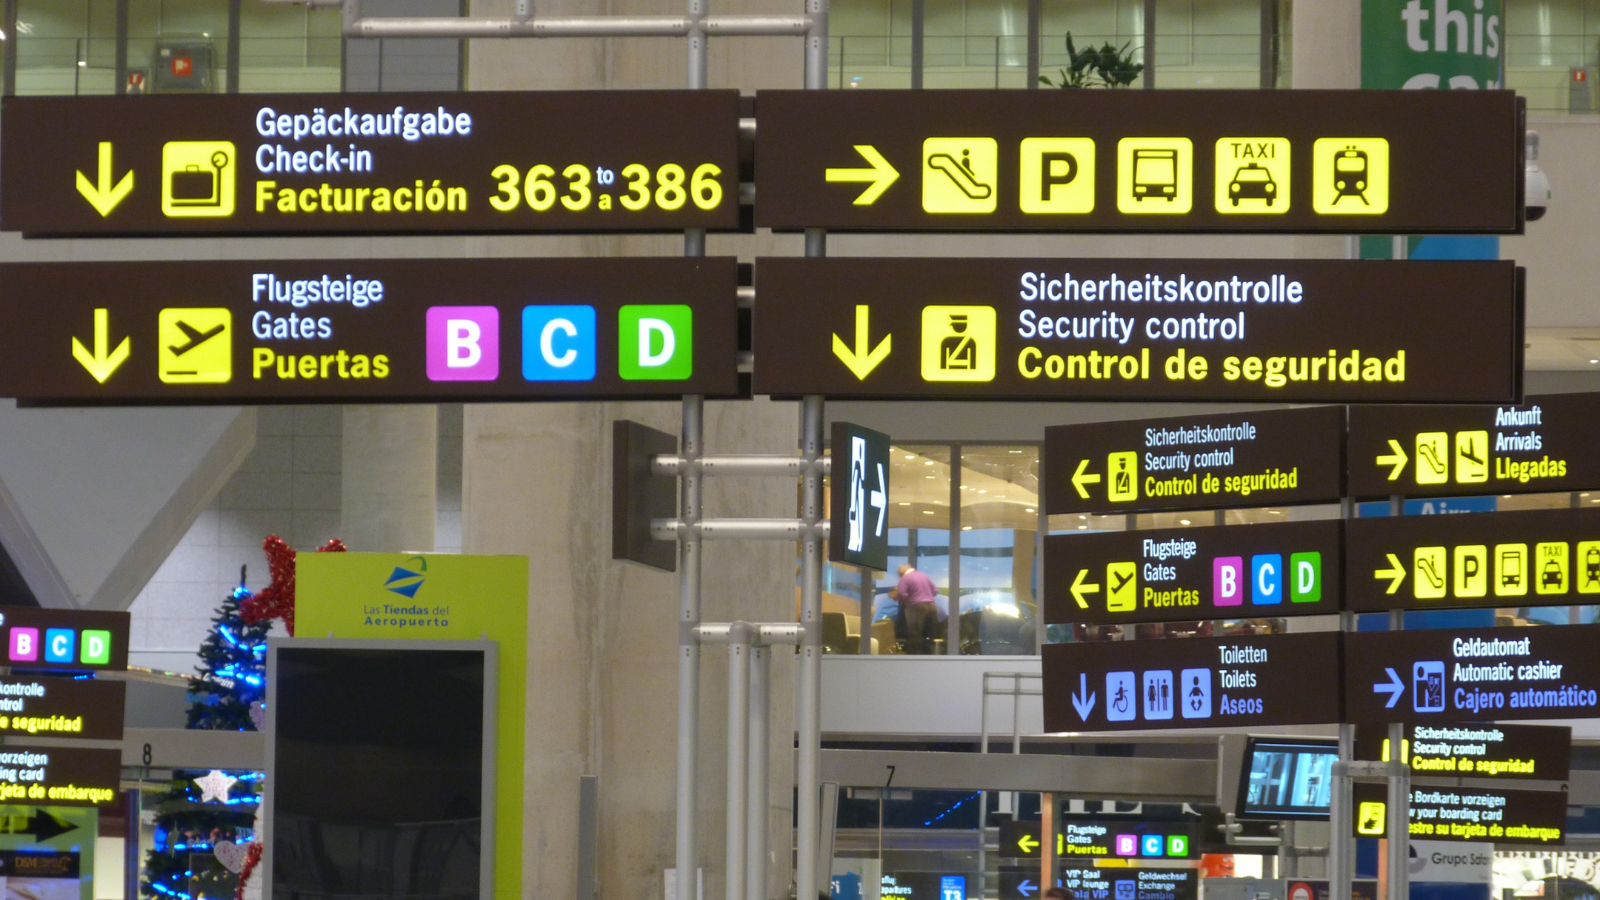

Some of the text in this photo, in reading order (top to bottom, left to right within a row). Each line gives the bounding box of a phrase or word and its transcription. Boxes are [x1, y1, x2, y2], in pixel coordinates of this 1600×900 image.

[1401, 0, 1499, 58] this
[255, 105, 472, 142] Gepäckaufgabe
[255, 143, 373, 173] Check-in
[1231, 143, 1275, 158] TAXI
[489, 162, 723, 211] 363 to a 386
[1041, 152, 1078, 201] P
[255, 180, 467, 212] Facturación
[252, 272, 384, 308] Flugsteige
[1019, 272, 1304, 304] Sicherheitskontrolle
[252, 309, 333, 340] Gates
[1018, 309, 1245, 344] Security control
[447, 317, 676, 368] B C D
[252, 348, 390, 379] Puertas
[1017, 347, 1406, 388] Control de seguridad
[1495, 405, 1542, 427] Ankunft
[1145, 421, 1256, 447] Sicherheitskontrolle
[1496, 431, 1542, 451] Arrivals
[1145, 447, 1234, 472] Security control
[1496, 455, 1566, 484] Llegadas
[1145, 467, 1298, 497] Control de seguridad
[1143, 538, 1197, 560] Flugsteige
[1543, 545, 1563, 557] TAXI
[1143, 563, 1177, 581] Gates
[1221, 561, 1315, 598] B C D
[1463, 554, 1479, 589] P
[1143, 587, 1200, 608] Puertas
[364, 604, 450, 616] Las Tiendas del
[364, 616, 450, 628] Aeropuerto
[17, 633, 104, 658] B C D
[1218, 645, 1268, 665] Toiletten
[1453, 636, 1531, 657] Geldautomat
[1218, 670, 1257, 688] Toilets
[1453, 660, 1563, 682] Automatic cashier
[1219, 694, 1264, 715] Aseos
[1453, 684, 1598, 713] Cajero automático
[11, 714, 83, 734] seguridad
[1413, 725, 1505, 742] Sicherheitskontrolle
[143, 743, 152, 766] 8
[1412, 740, 1487, 757] Security control
[19, 766, 45, 781] card
[1411, 755, 1536, 775] Control de seguridad
[886, 765, 896, 787] 7
[28, 782, 46, 799] de
[48, 784, 114, 804] embarque
[1415, 790, 1460, 804] Bordkarte
[1461, 794, 1506, 808] vorzeigen
[1417, 807, 1438, 820] your
[1439, 807, 1480, 822] boarding
[1481, 809, 1503, 821] card
[1066, 834, 1093, 844] Gates
[1067, 824, 1107, 836] Flugsteige
[1436, 823, 1450, 835] su
[1450, 823, 1487, 839] tarjeta
[1488, 824, 1504, 837] de
[1505, 825, 1561, 842] embarque
[1067, 844, 1108, 855] Puertas
[1121, 837, 1185, 853] B C D
[1432, 852, 1468, 868] Grupo
[1066, 869, 1081, 879] VIP
[1138, 871, 1188, 881] Geldwechsel
[1066, 879, 1109, 891] VIP lounge
[1091, 889, 1109, 899] VIP
[1138, 881, 1176, 892] Exchange
[1138, 891, 1175, 900] Cambio
